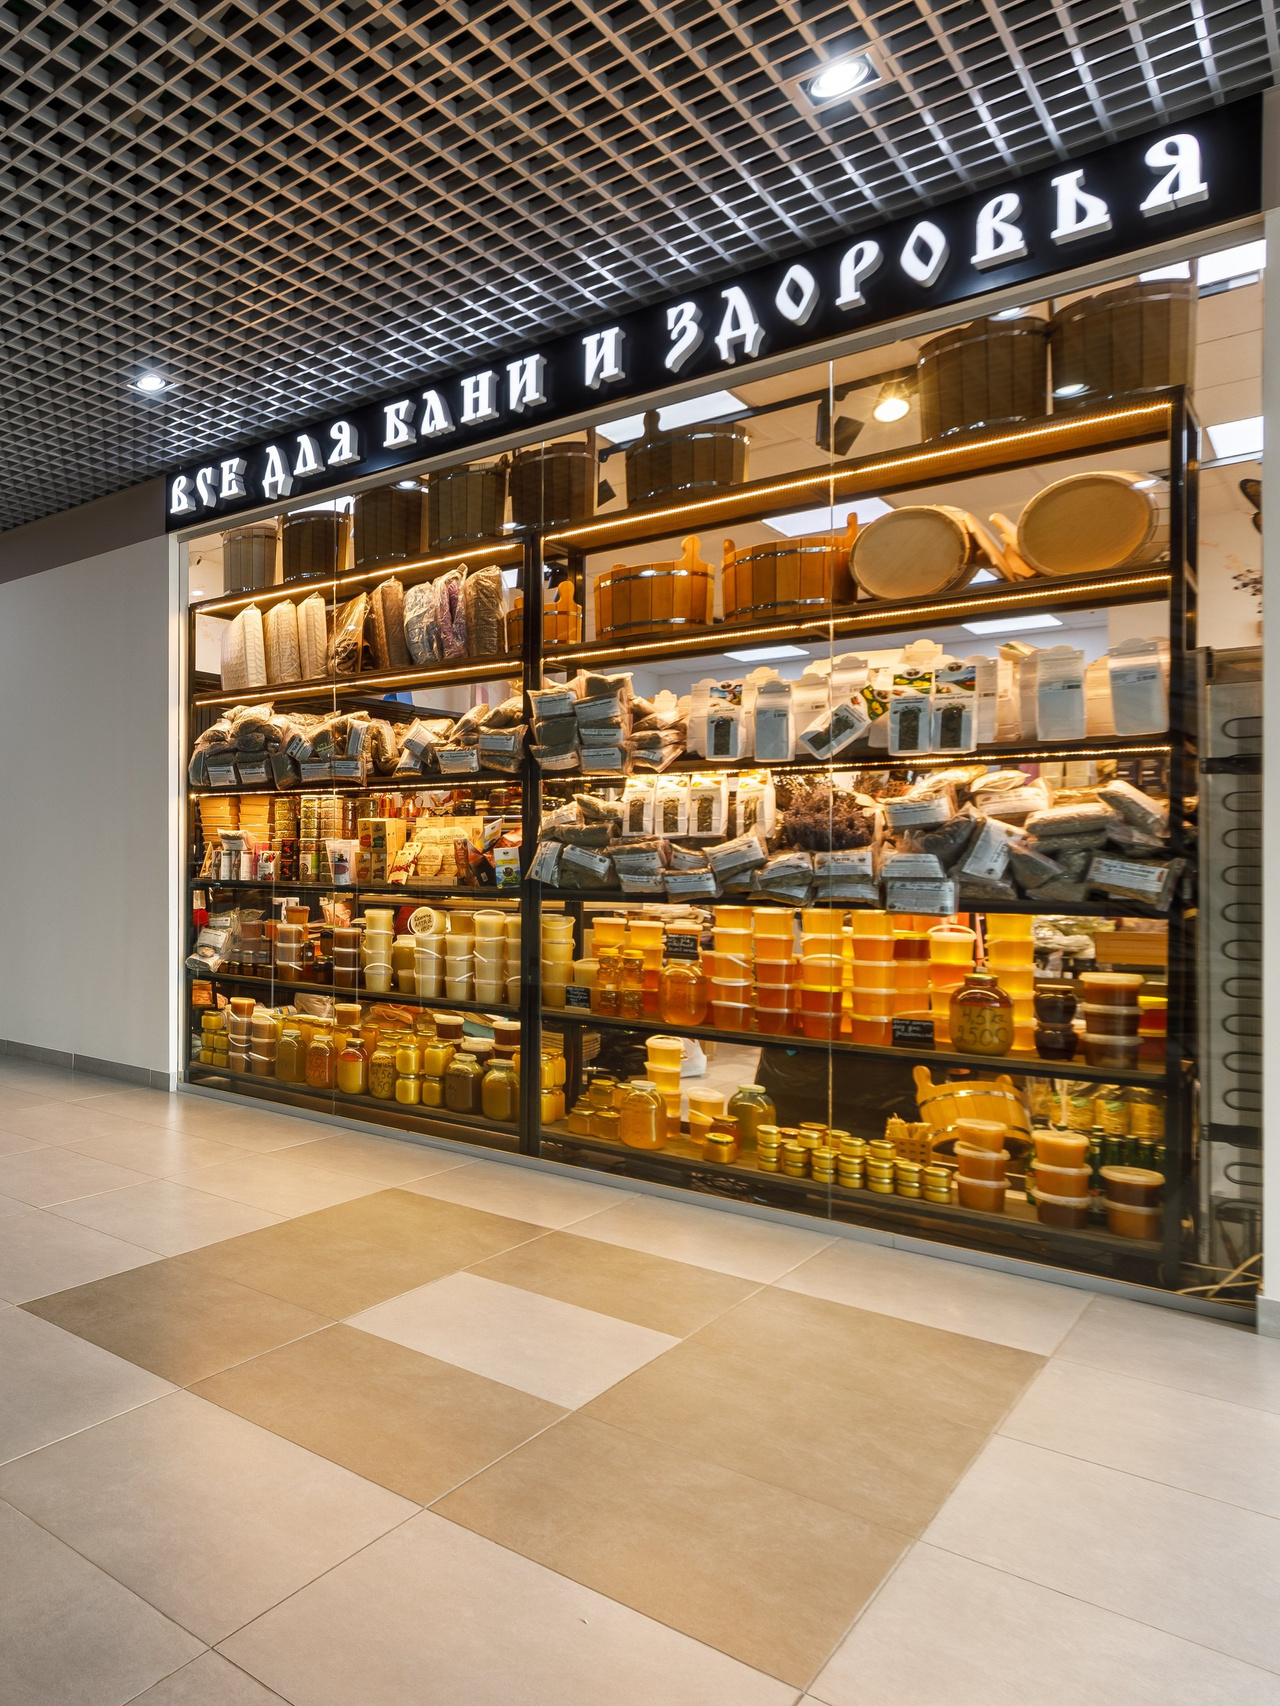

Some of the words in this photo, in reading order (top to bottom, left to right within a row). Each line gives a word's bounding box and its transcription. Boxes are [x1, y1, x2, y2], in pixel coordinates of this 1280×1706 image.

[170, 475, 247, 515] ВСЕ
[262, 421, 360, 498] ДЛЯ
[383, 353, 547, 450] БАНИ
[582, 326, 626, 390] И
[665, 133, 1210, 373] ЗДОРОВЬЯ
